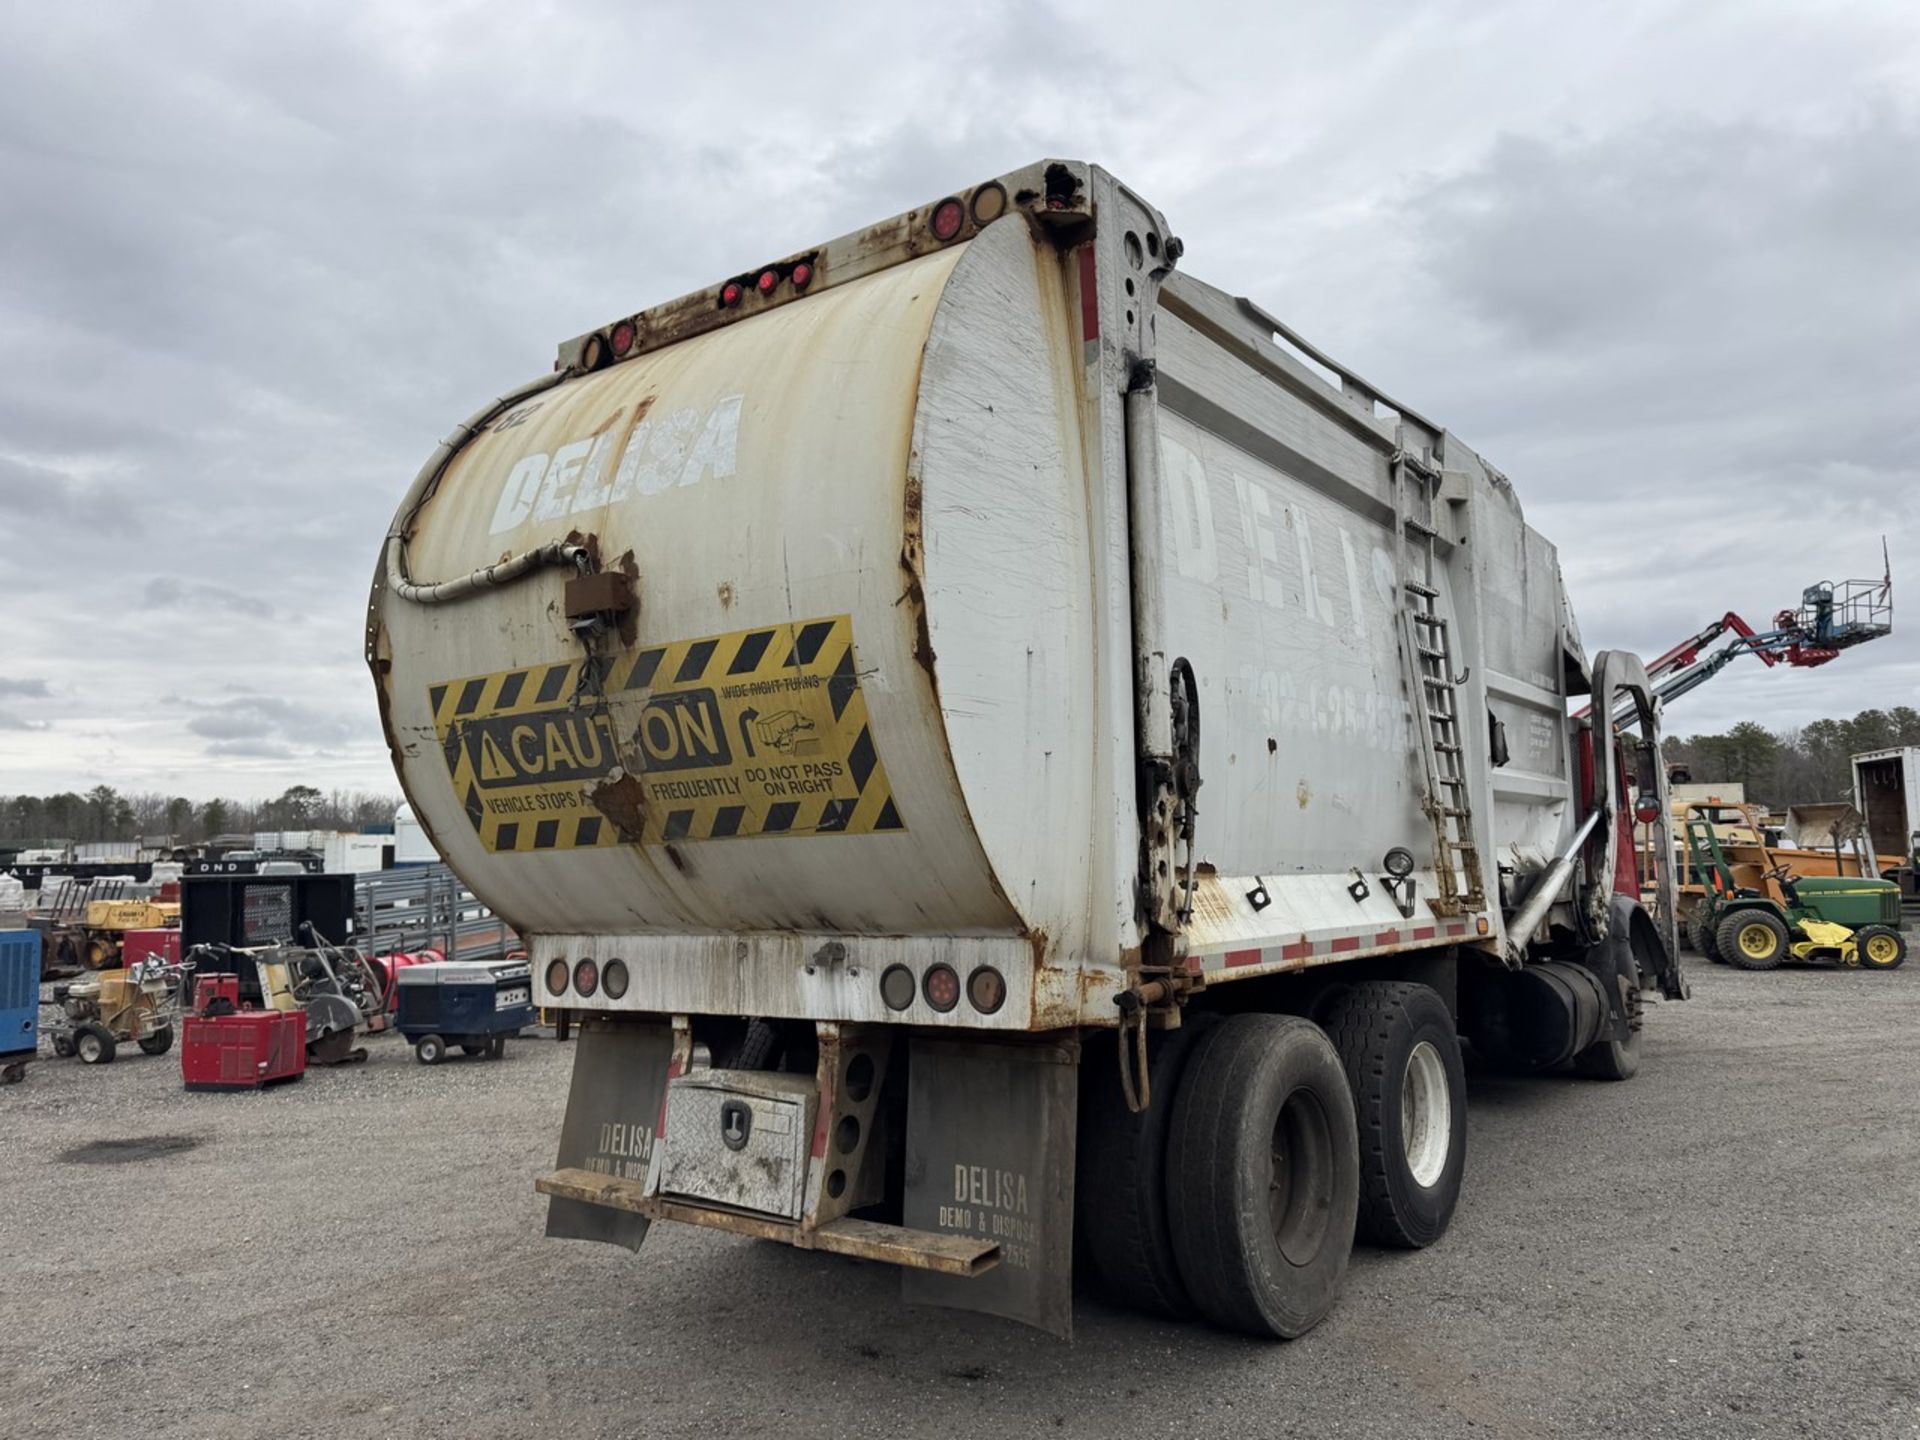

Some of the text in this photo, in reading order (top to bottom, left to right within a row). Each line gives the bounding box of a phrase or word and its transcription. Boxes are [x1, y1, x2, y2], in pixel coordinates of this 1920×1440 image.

[488, 393, 744, 535] DELISA
[721, 682, 749, 700] WIDE
[750, 679, 782, 696] RIGHT
[745, 761, 843, 782] DO NOT PASS
[651, 776, 742, 801] FREQUENTLY
[763, 778, 833, 796] ON RIGHT
[486, 794, 537, 815] VEHICLE
[537, 792, 575, 812] STOPS
[598, 1123, 652, 1160] DELISA
[585, 1157, 611, 1176] DEMO
[954, 1163, 1028, 1215] DELISA
[939, 1206, 972, 1229] DEMO
[978, 1211, 986, 1232] &
